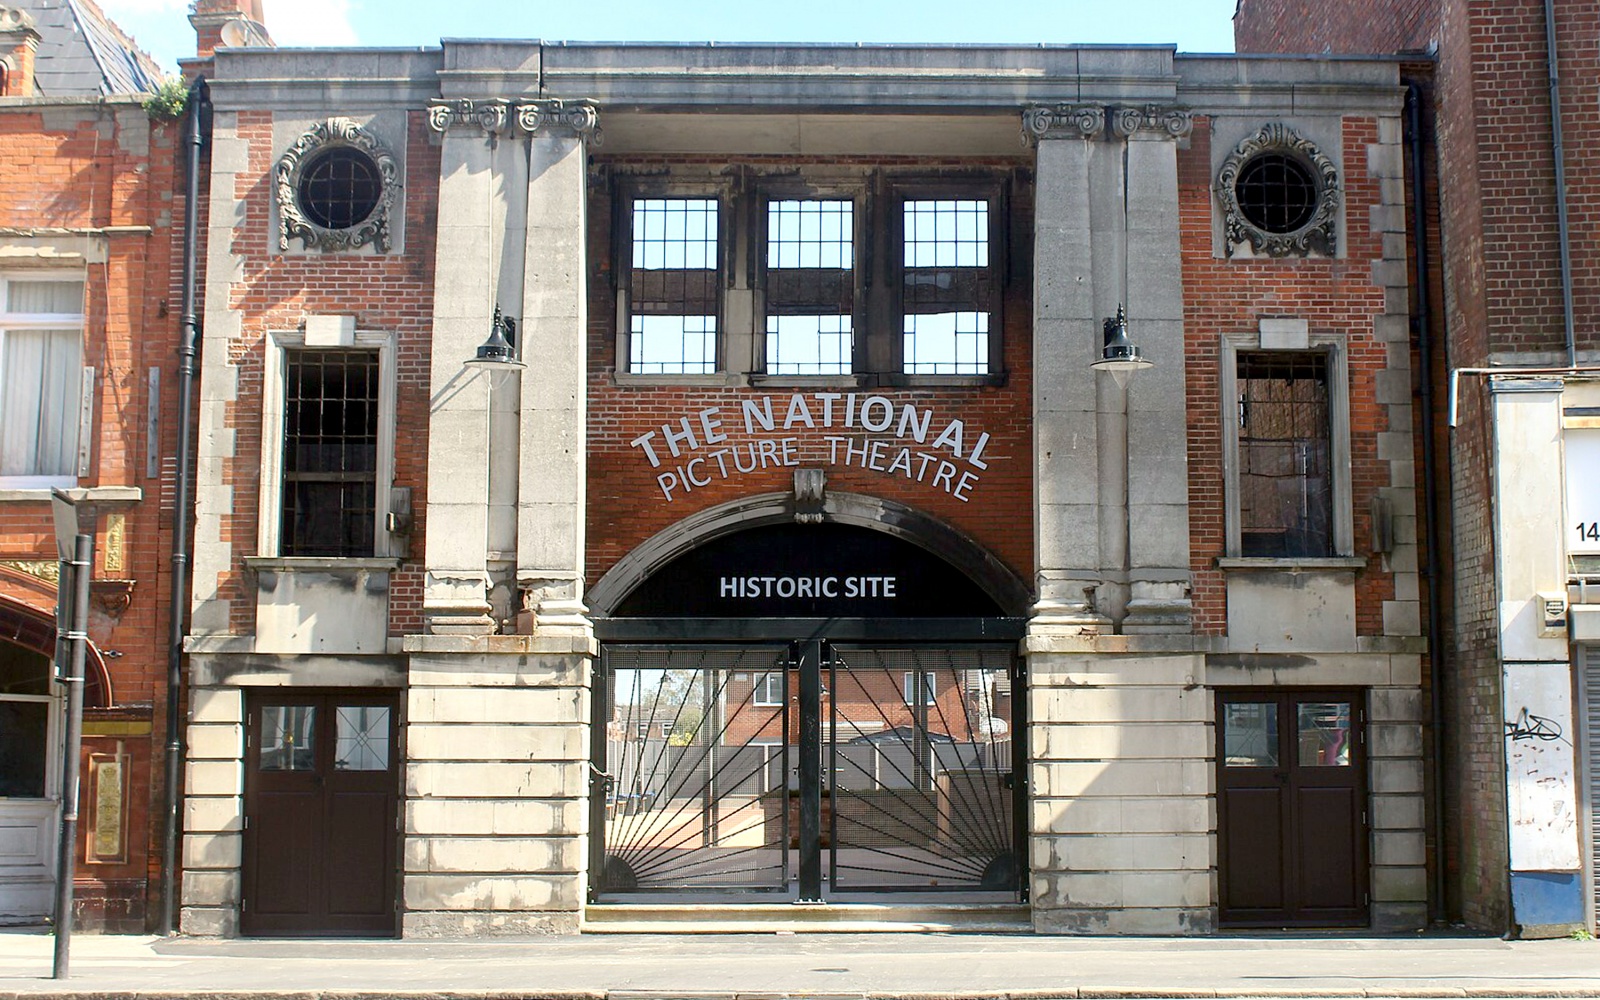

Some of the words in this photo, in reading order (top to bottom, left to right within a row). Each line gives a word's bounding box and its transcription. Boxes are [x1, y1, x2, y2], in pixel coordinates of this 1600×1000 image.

[630, 406, 728, 469] THE
[741, 392, 991, 471] NATIONAL
[656, 436, 800, 502] PICTURE
[823, 435, 980, 503] THEATRE
[719, 576, 838, 598] HISTORIC
[844, 576, 896, 598] SITE
